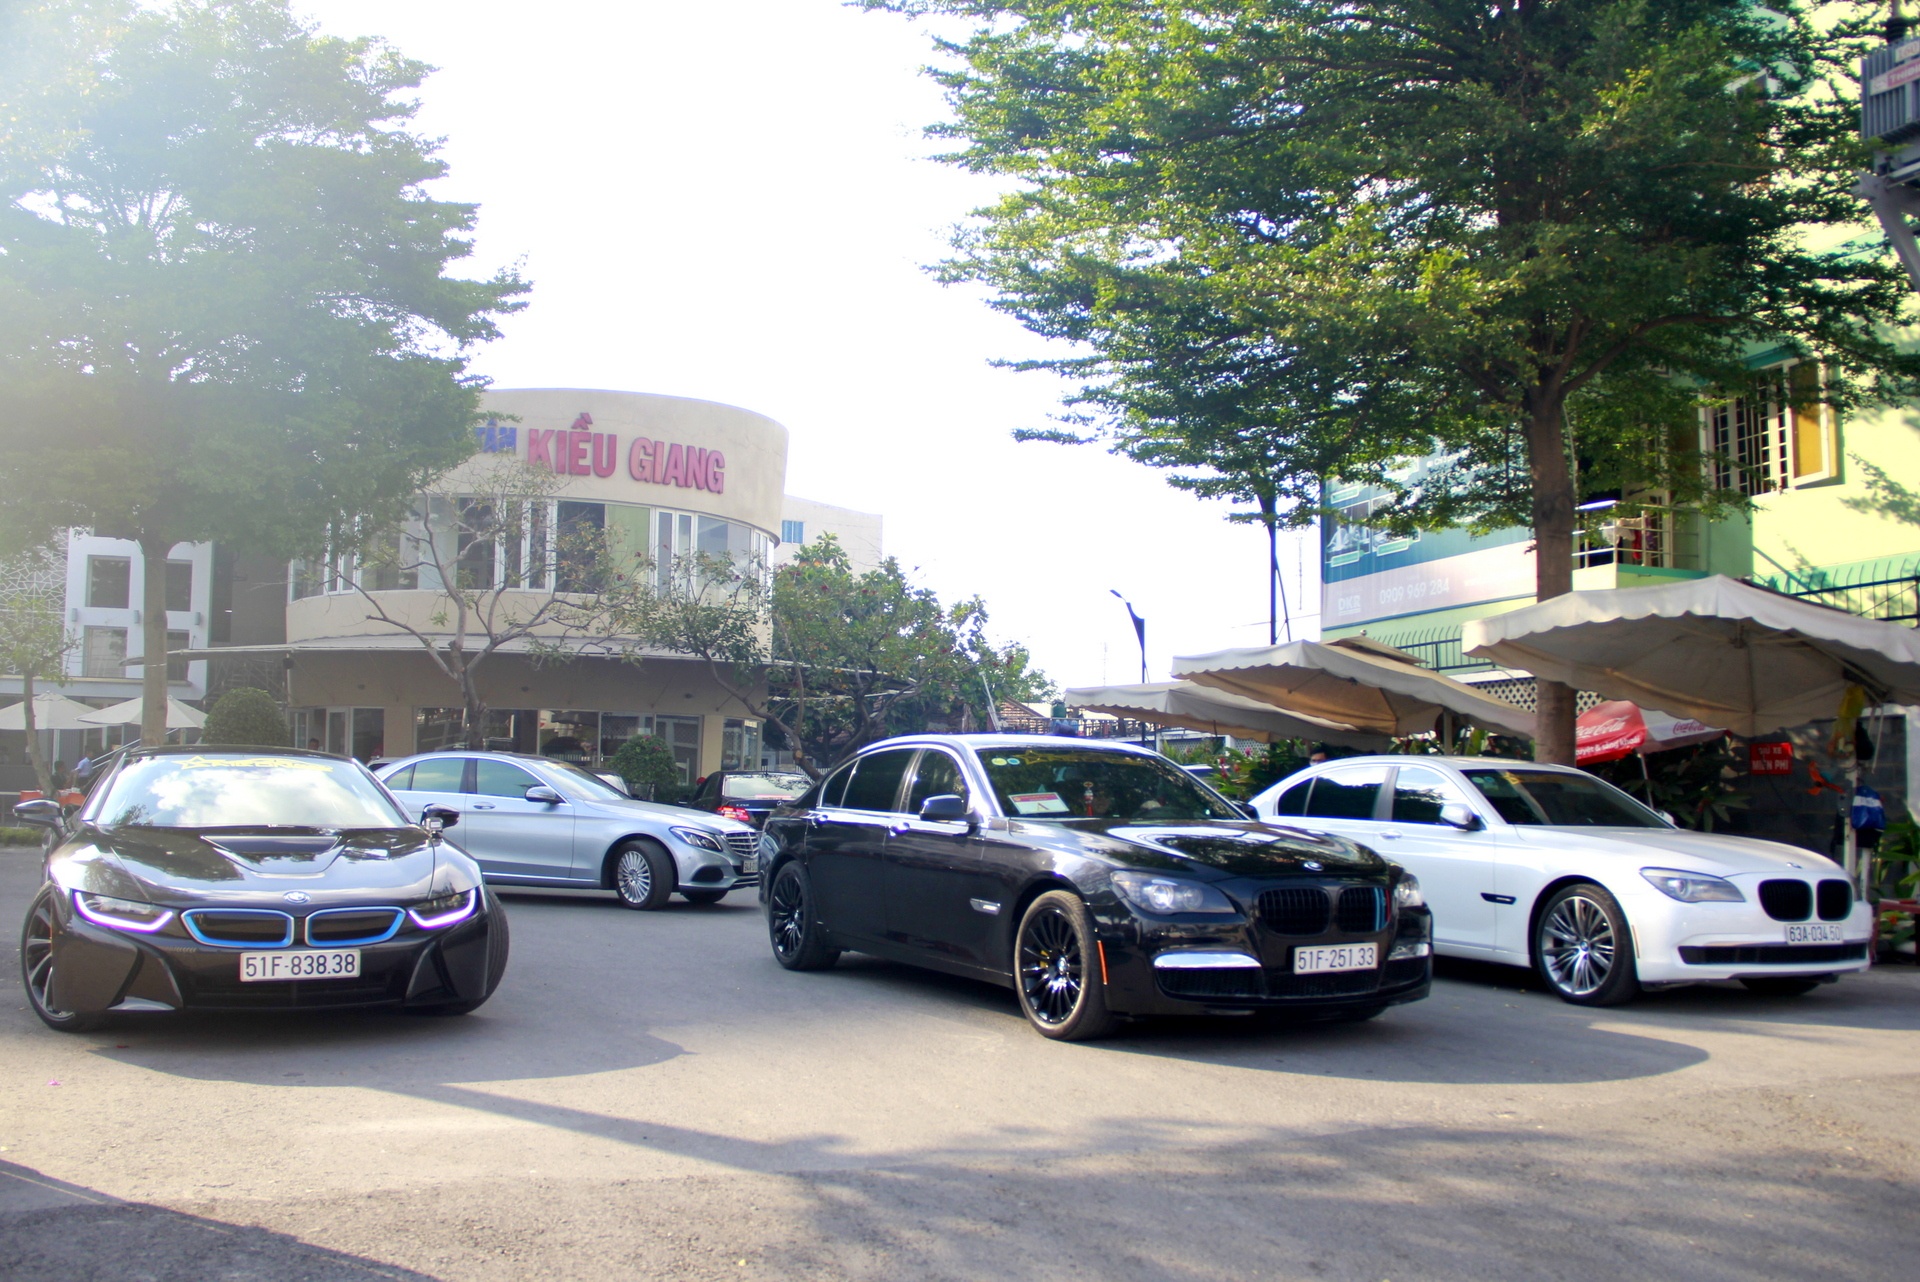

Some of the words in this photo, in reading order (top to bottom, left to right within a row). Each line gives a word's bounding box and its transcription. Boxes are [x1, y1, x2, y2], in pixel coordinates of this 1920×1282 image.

[527, 412, 617, 478] KIỀU
[628, 437, 725, 494] GIANG
[1379, 586, 1404, 605] 0909
[1407, 582, 1426, 600] 969
[1430, 578, 1449, 595] 284
[245, 953, 355, 977] 51F-838.38
[1298, 947, 1374, 970] 51F-251.33
